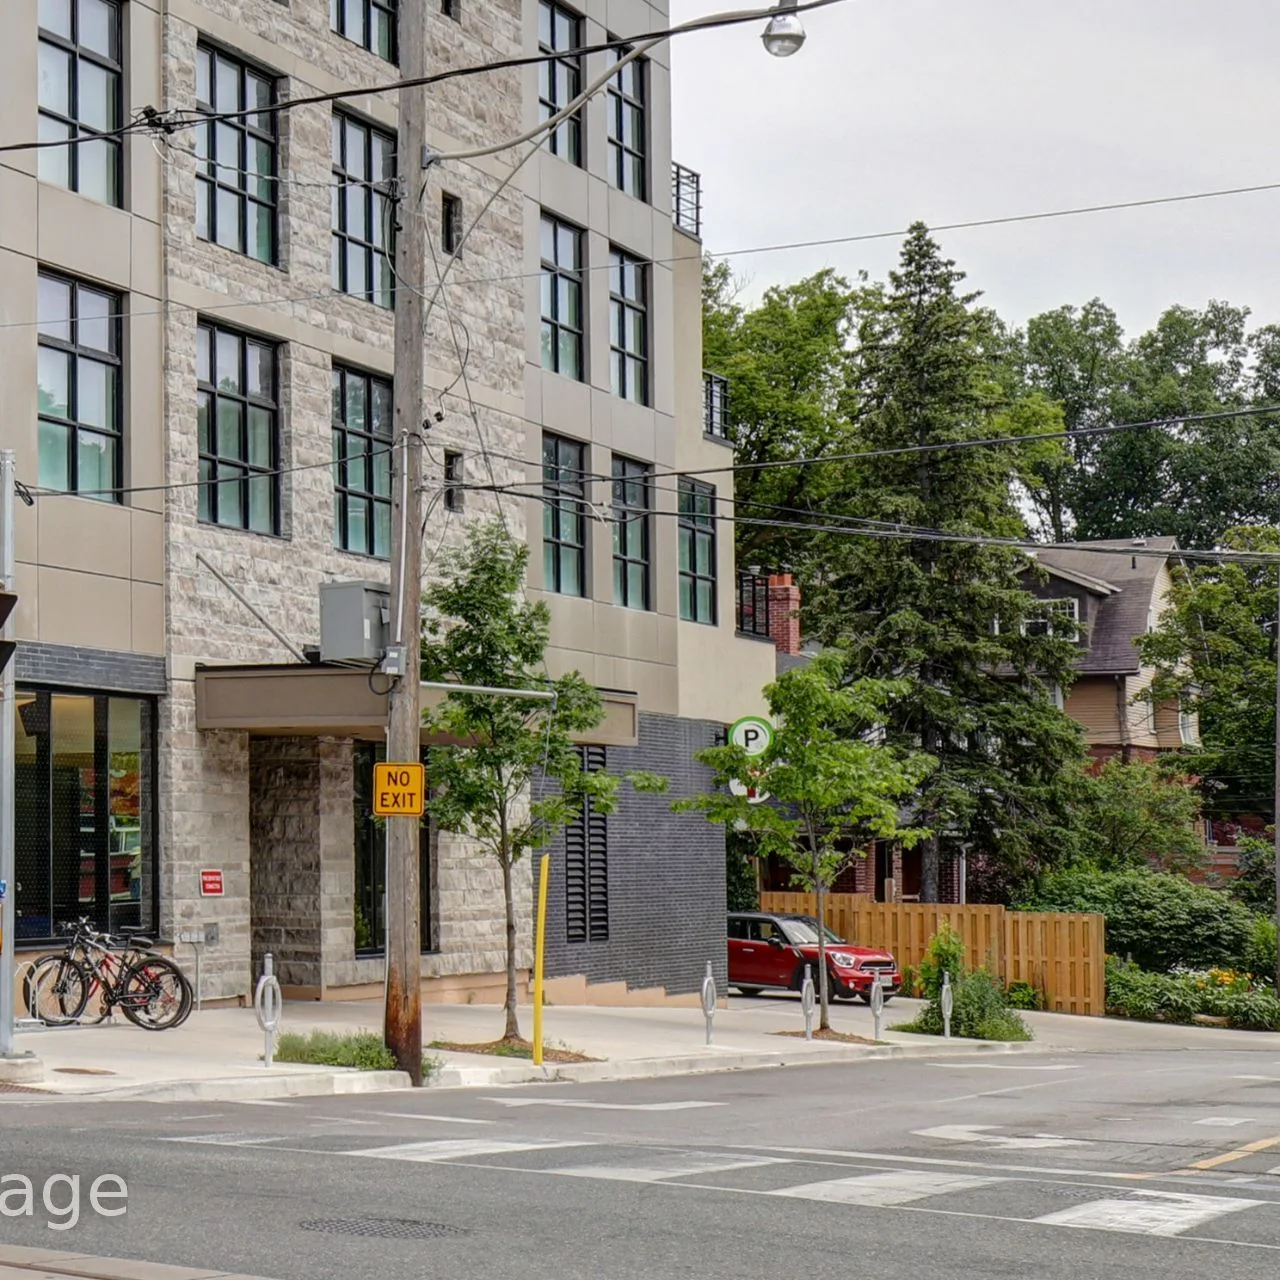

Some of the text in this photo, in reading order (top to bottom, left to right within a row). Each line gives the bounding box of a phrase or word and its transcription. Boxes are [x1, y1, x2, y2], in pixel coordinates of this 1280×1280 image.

[744, 729, 759, 747] P
[387, 771, 410, 787] NO
[380, 792, 416, 808] EXIT
